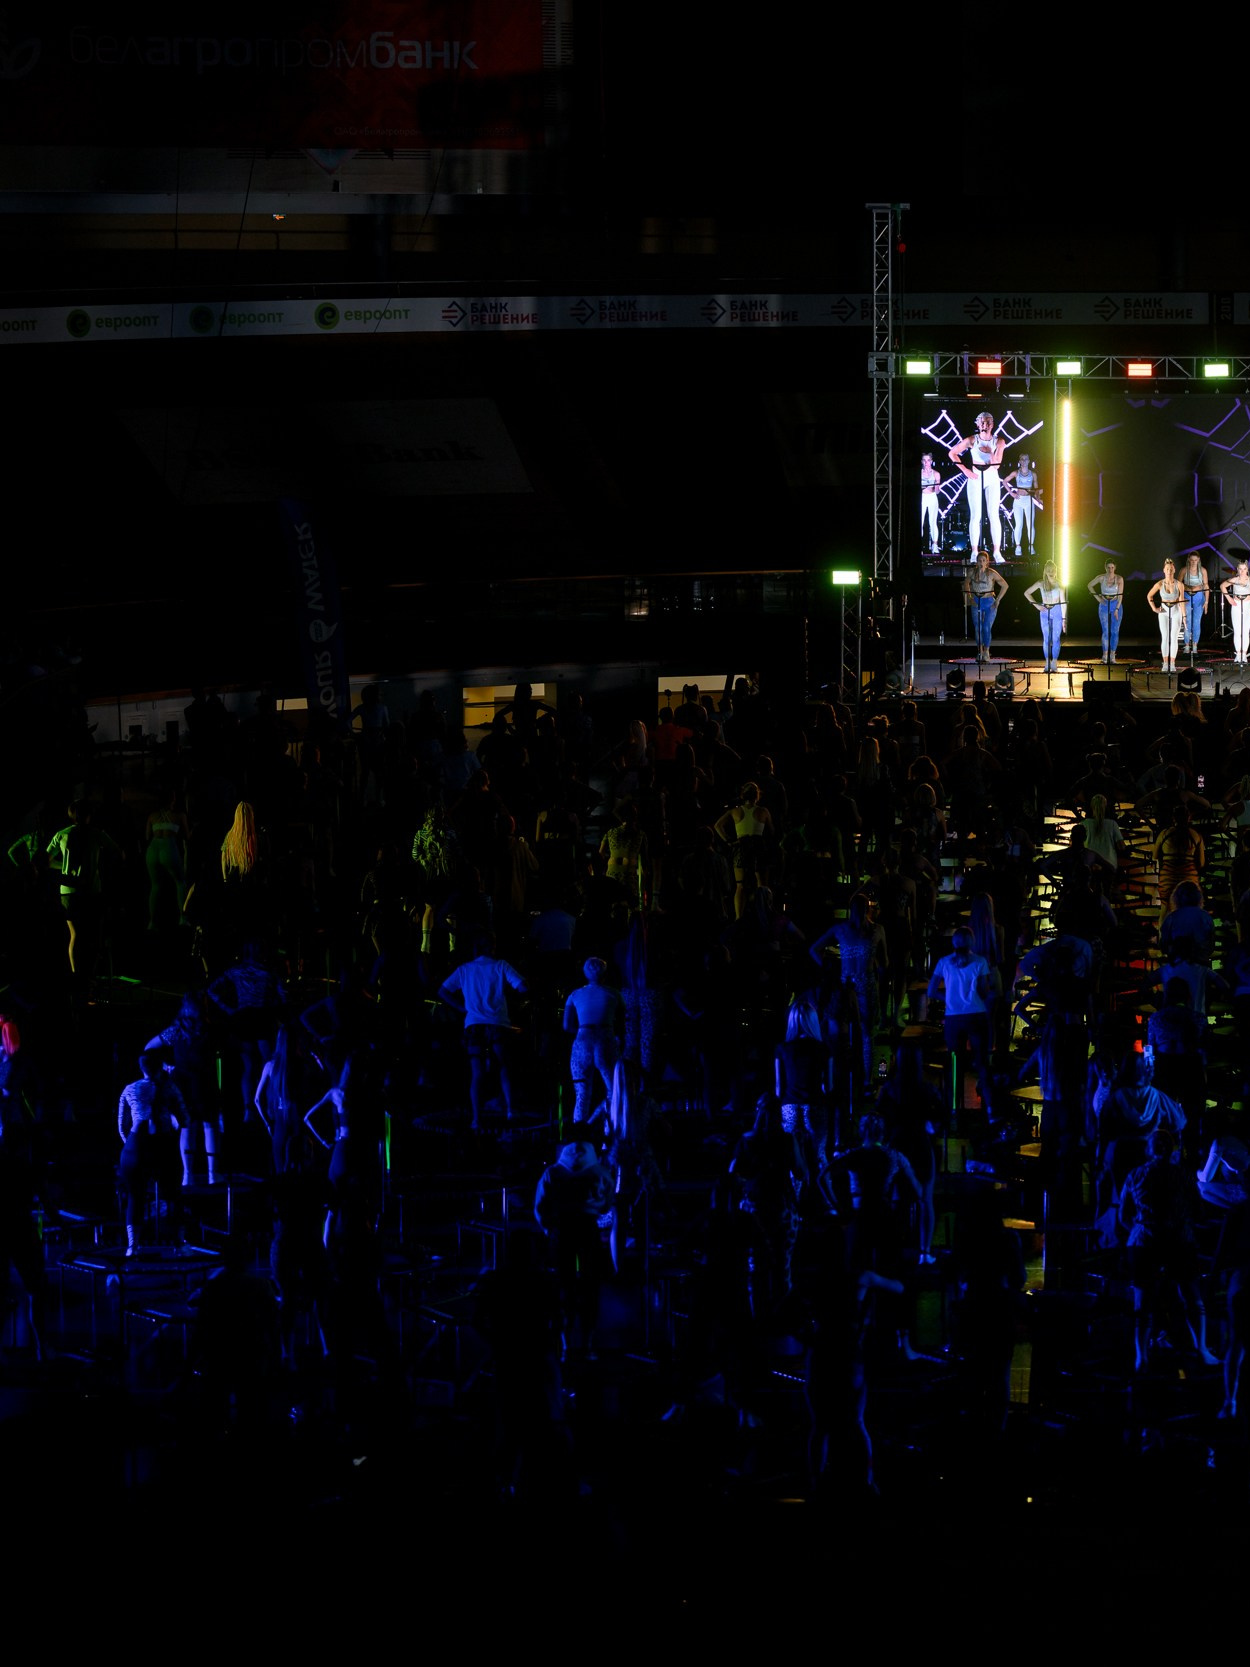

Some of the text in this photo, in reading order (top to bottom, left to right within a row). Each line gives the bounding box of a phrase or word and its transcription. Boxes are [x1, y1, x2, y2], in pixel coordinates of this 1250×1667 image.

[471, 302, 508, 313] БАНК
[599, 300, 638, 312] БАНК
[730, 300, 768, 311] БАНК
[993, 298, 1032, 308] БАНК
[1124, 298, 1163, 308] БАНК
[344, 308, 411, 324] евроопт
[471, 313, 538, 325] РЕШЕНИЕ
[599, 311, 668, 323] РЕШЕНИЕ
[730, 311, 799, 322] РЕШЕНИЕ
[993, 308, 1063, 320] РЕШЕНИЕ
[1124, 308, 1193, 320] РЕШЕНИЕ
[96, 314, 159, 331] евроопт
